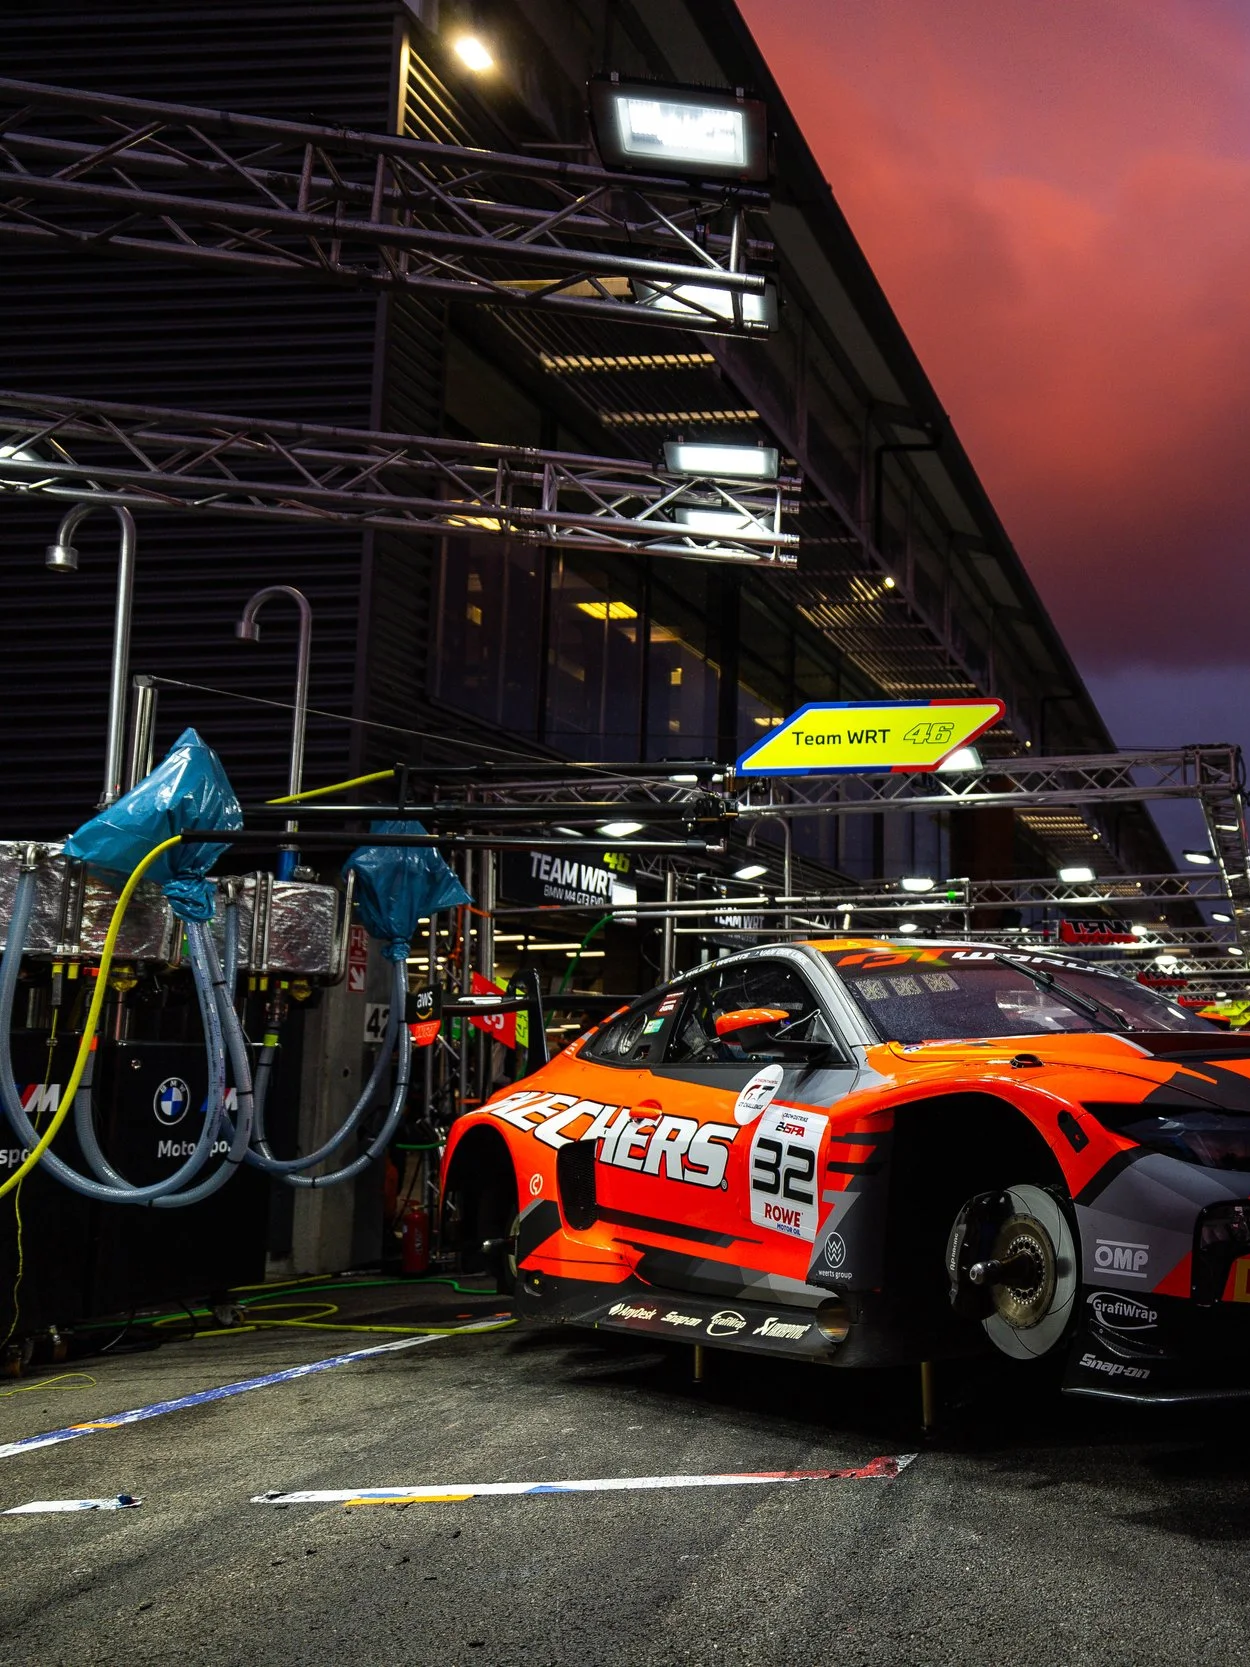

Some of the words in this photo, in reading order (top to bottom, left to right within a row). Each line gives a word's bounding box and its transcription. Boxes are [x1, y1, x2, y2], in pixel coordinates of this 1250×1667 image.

[791, 731, 842, 746] Team
[847, 729, 891, 744] WRT
[903, 722, 955, 745] 46
[530, 851, 579, 888] TEAM
[580, 864, 617, 897] WRT
[543, 884, 564, 900] BMW
[564, 889, 576, 902] M4
[576, 892, 590, 906] GT3
[416, 991, 434, 1008] aws
[752, 1137, 816, 1205] 32
[764, 1203, 802, 1228] ROWE
[776, 1223, 793, 1234] MOTOR
[1094, 1246, 1149, 1272] OMP
[818, 1269, 835, 1278] weerts
[835, 1271, 853, 1280] group
[619, 1305, 657, 1320] AnyDesk
[660, 1311, 702, 1326] Snap-on
[1093, 1299, 1158, 1322] GrafiWrap
[1079, 1353, 1151, 1379] Snap-on
